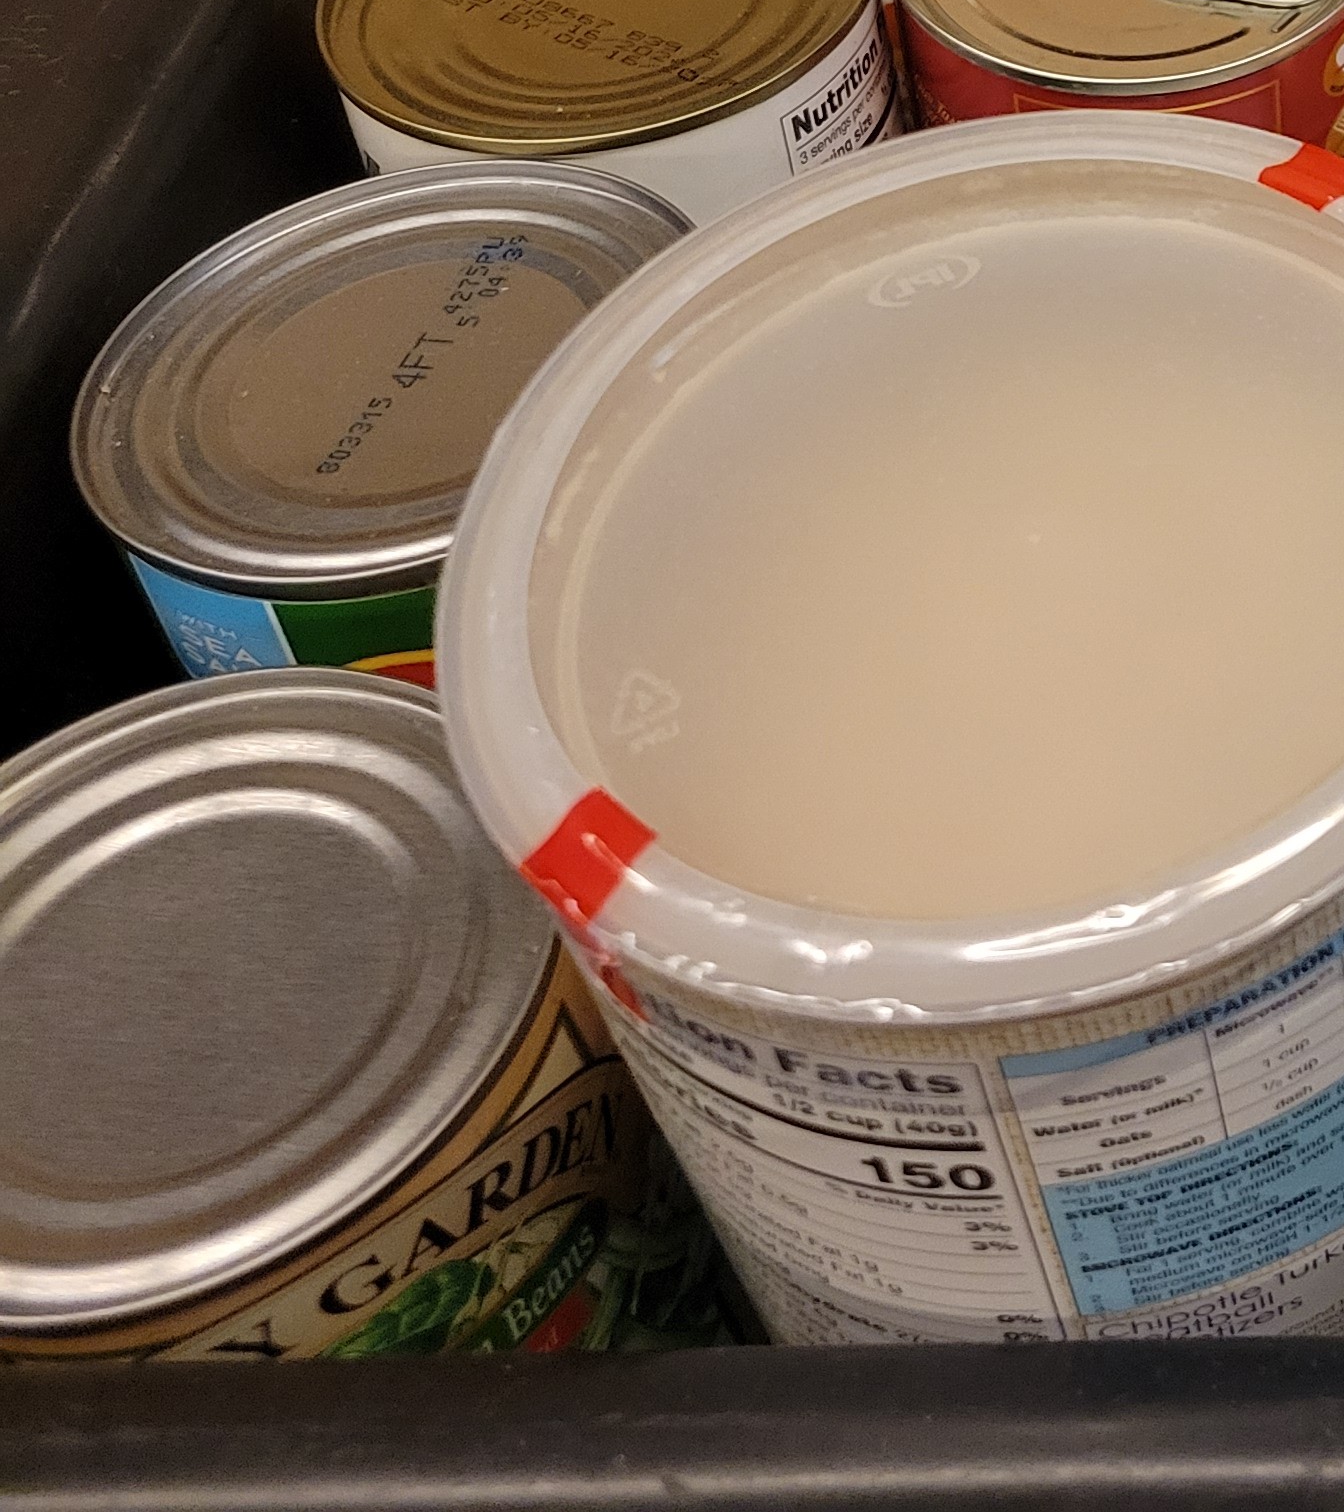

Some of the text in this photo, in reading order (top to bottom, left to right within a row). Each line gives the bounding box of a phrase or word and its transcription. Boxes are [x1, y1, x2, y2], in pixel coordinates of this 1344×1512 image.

[790, 38, 879, 144] Nutrition
[800, 150, 809, 165] 3
[810, 114, 852, 159] servings
[392, 331, 456, 391] 4FT
[1146, 940, 1337, 1046] PREPARATION
[771, 1046, 964, 1096] Facts
[1031, 1118, 1103, 1139] Water
[1279, 1036, 1311, 1062] cup
[1059, 1074, 1168, 1108] Servings
[825, 1108, 884, 1132] cup
[894, 1119, 979, 1138] (40g)
[1099, 1130, 1154, 1149] Oats
[860, 1155, 996, 1192] 150
[1056, 1163, 1104, 1179] Salt
[1110, 1134, 1206, 1172] (Optional)
[318, 1092, 623, 1316] GARDEN
[502, 1222, 598, 1348] Beans
[1098, 1284, 1264, 1338] Chipotle
